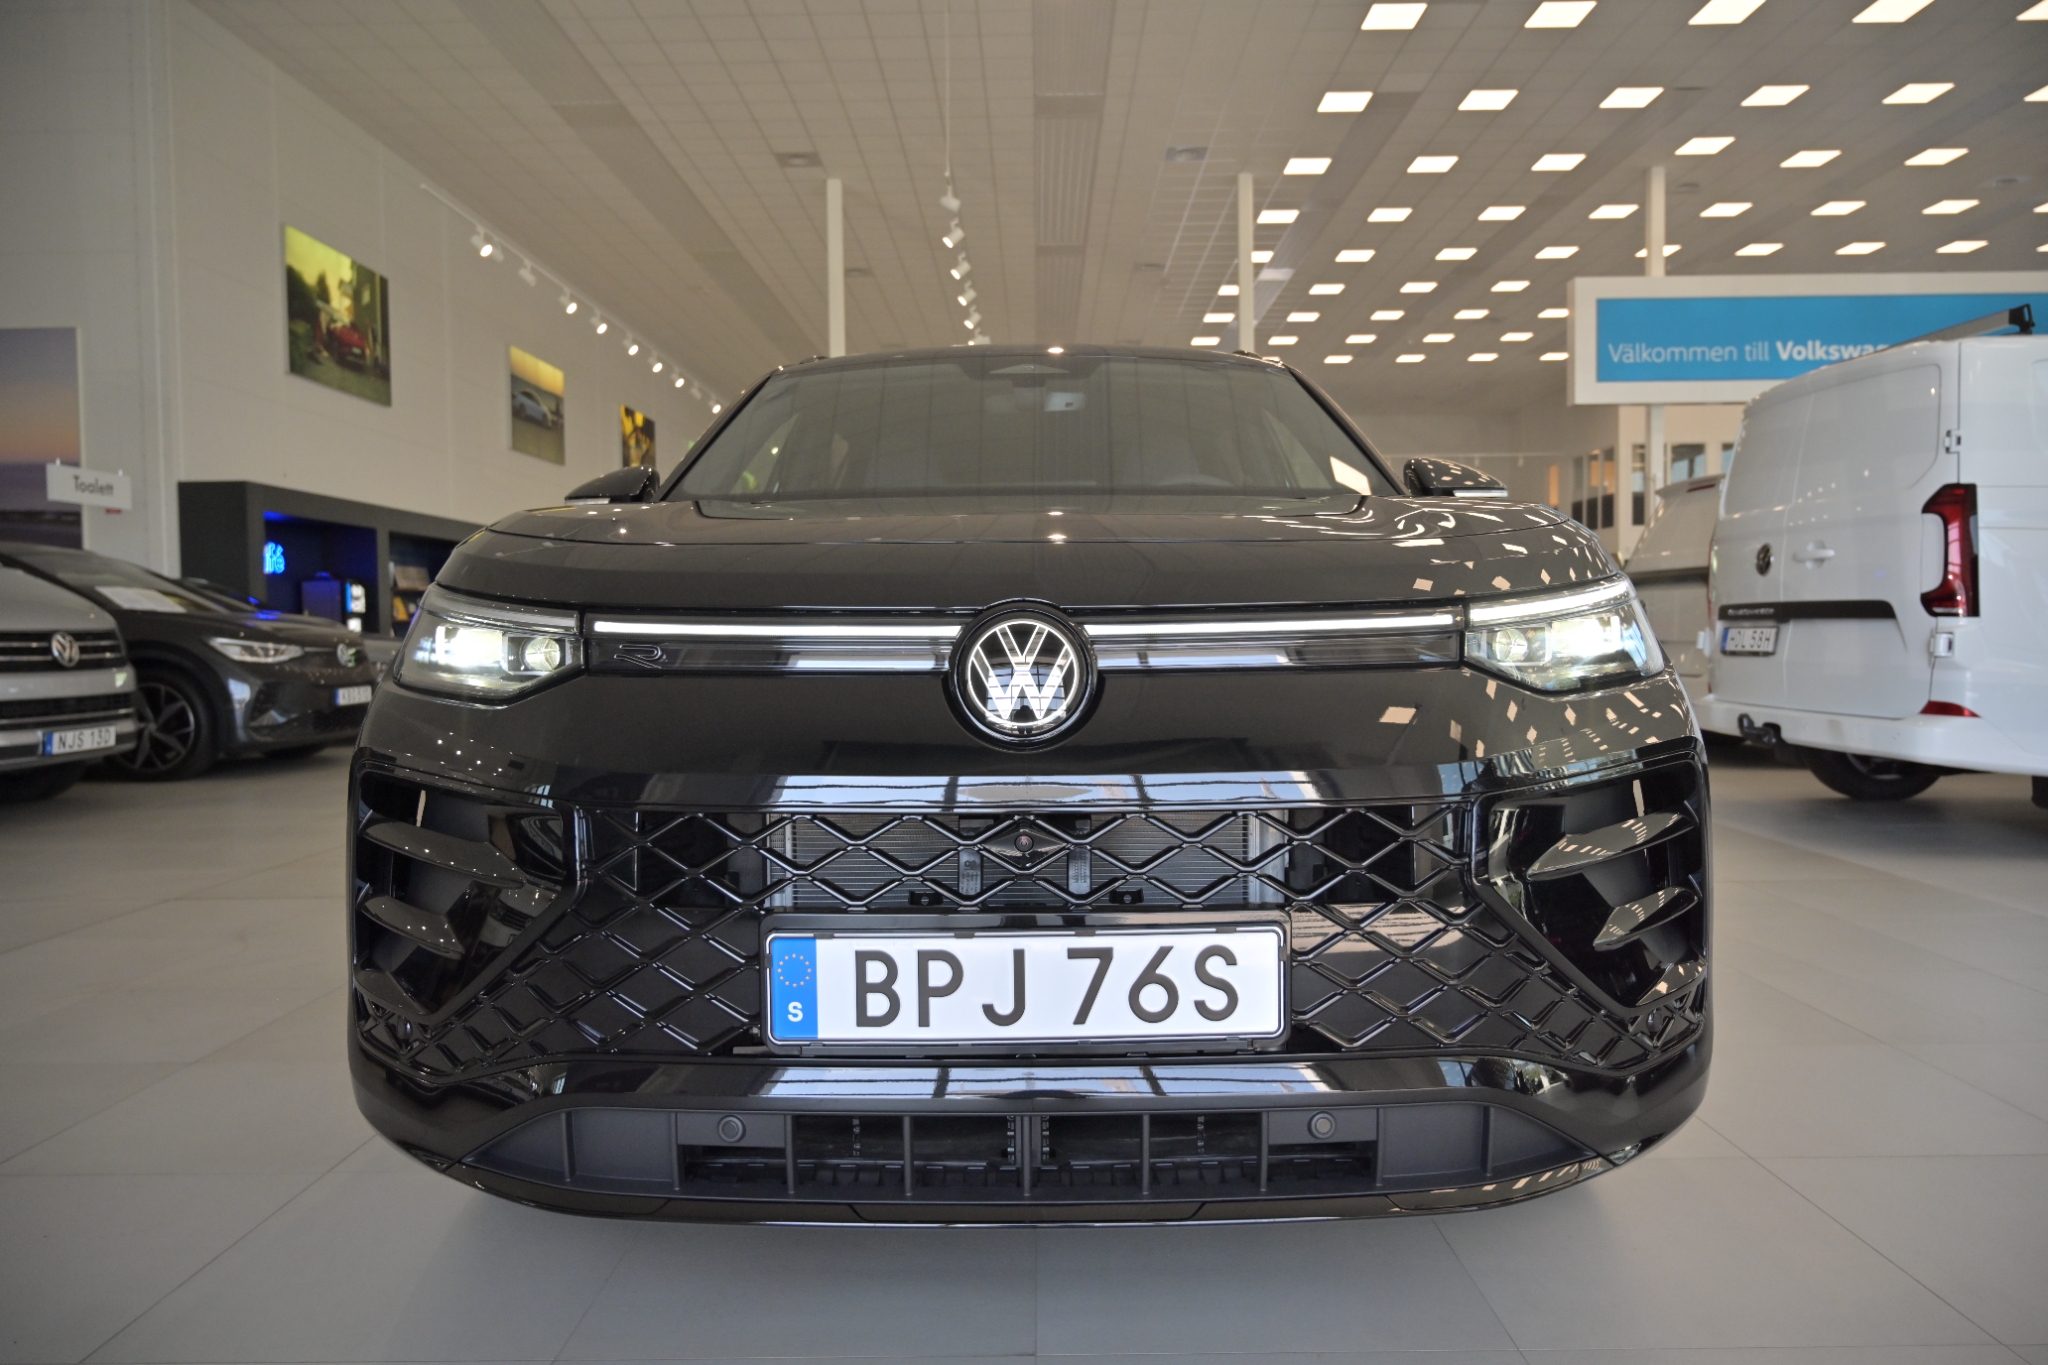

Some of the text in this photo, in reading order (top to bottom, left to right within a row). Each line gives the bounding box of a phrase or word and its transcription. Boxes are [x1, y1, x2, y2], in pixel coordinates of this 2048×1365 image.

[1608, 343, 1738, 363] Välkommen
[1744, 340, 1770, 362] till
[57, 732, 85, 750] NJS
[855, 945, 1239, 1028] BPJ 76S
[787, 1001, 804, 1023] S
